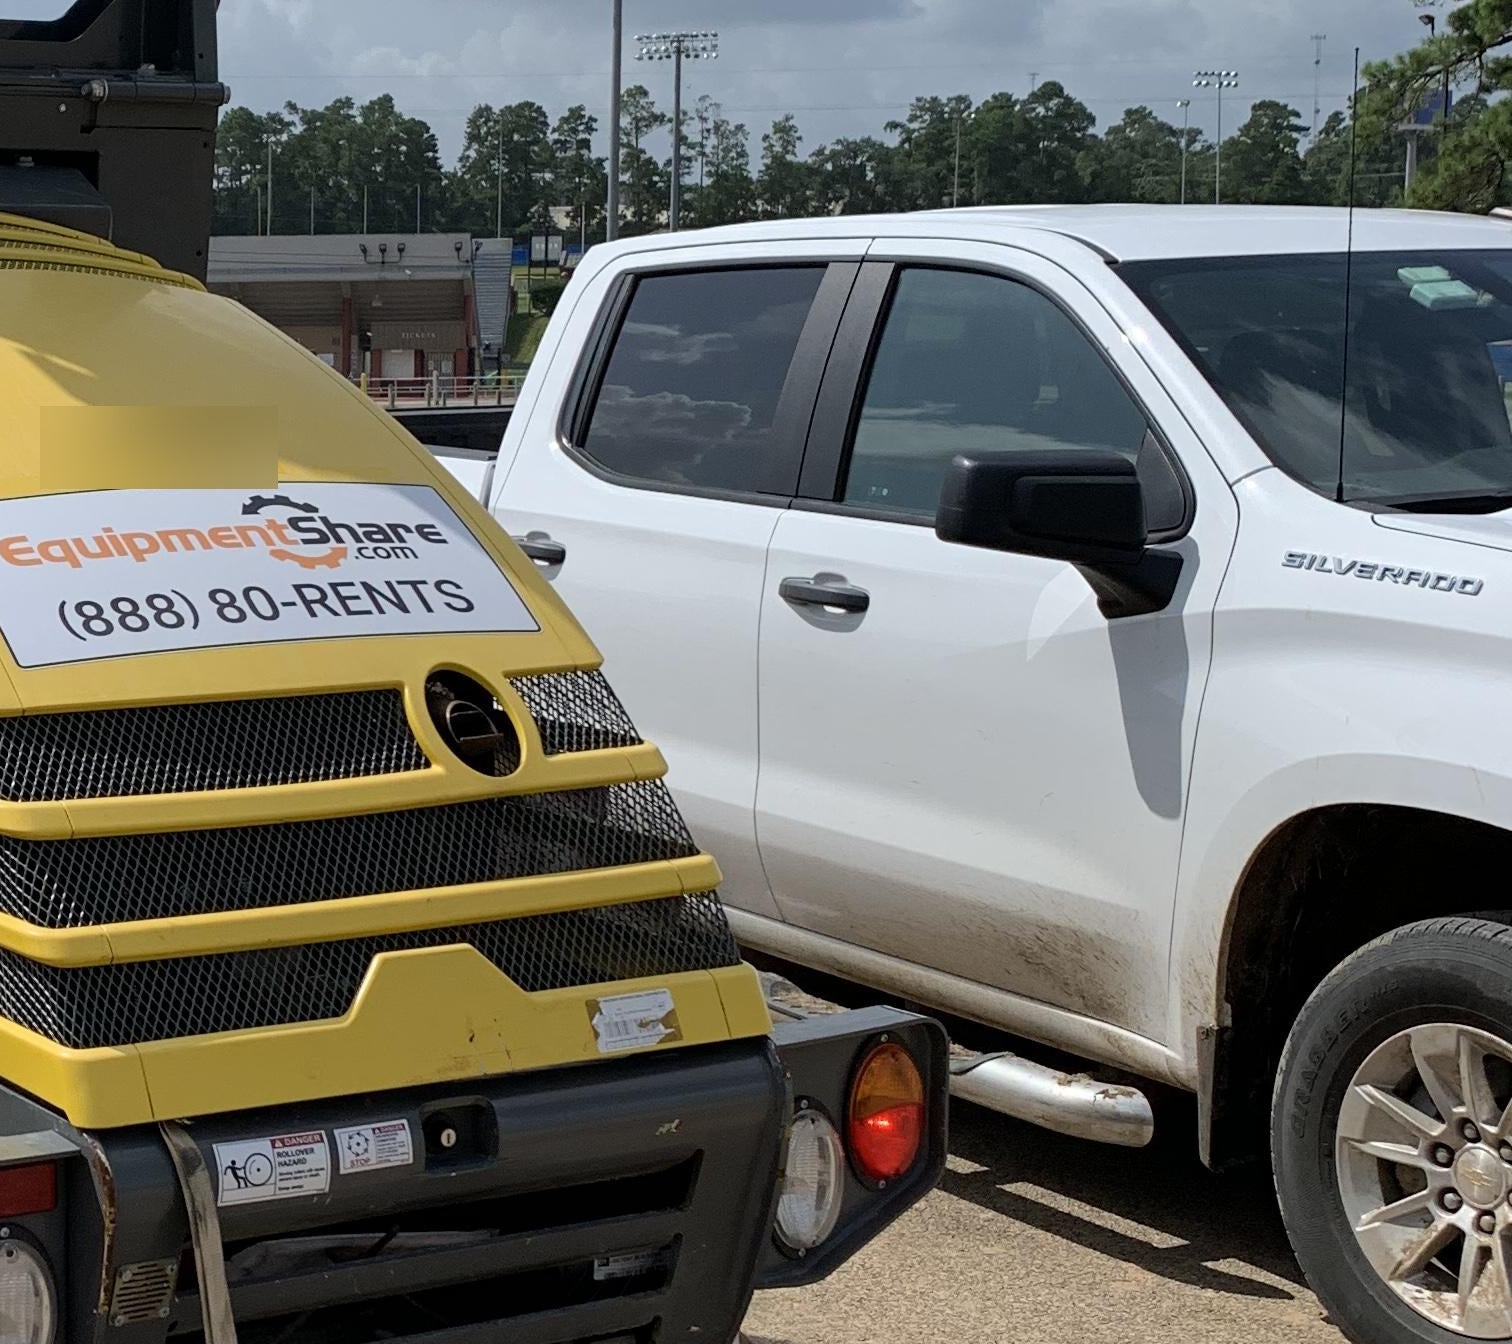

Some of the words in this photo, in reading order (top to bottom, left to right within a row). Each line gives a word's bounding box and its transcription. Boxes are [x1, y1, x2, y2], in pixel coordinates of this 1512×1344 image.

[354, 543, 419, 561] .com
[1281, 550, 1484, 596] SILVERADO
[58, 587, 201, 641] (888)
[209, 580, 475, 625] 80-RENTS
[284, 1134, 321, 1146] DANGER
[276, 1147, 315, 1158] ROLLOVER
[278, 1157, 307, 1167] HAZARD
[350, 1157, 371, 1168] STOP
